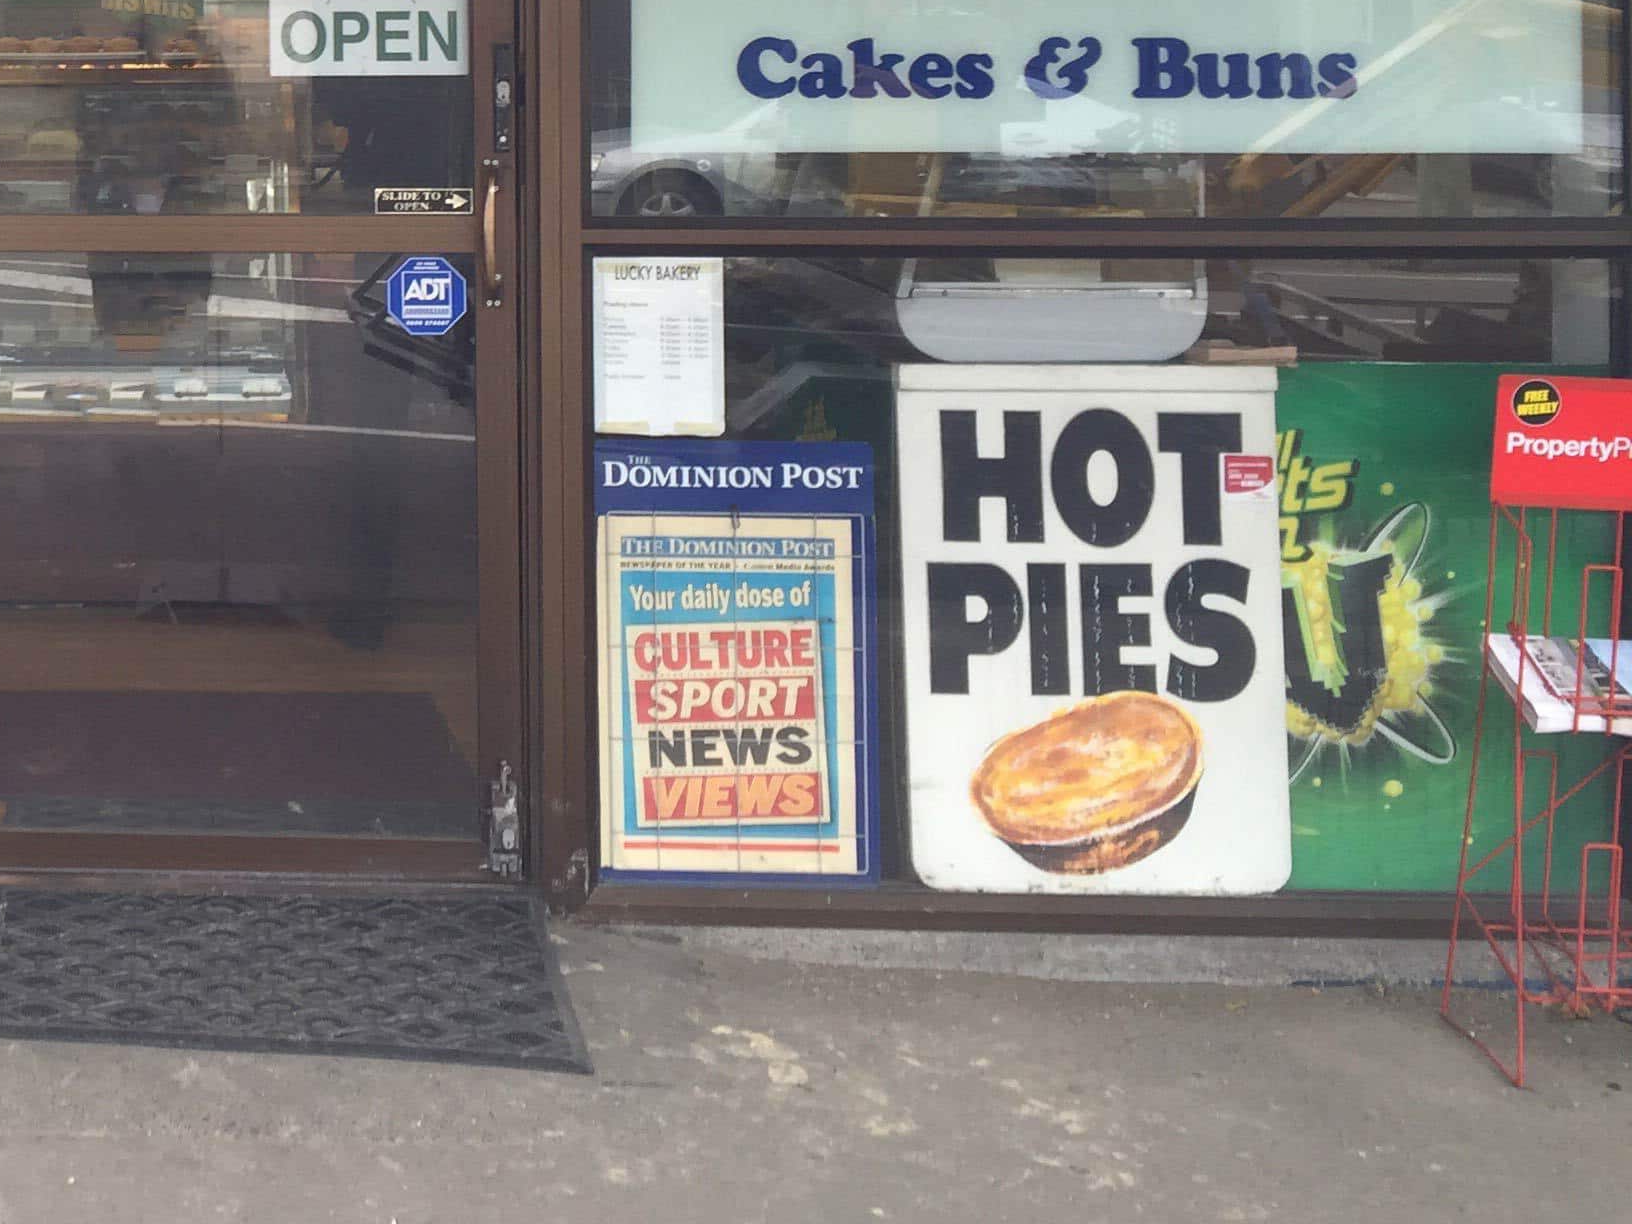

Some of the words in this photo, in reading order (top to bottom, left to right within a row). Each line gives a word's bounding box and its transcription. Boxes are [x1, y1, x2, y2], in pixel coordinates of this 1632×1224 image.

[280, 11, 458, 63] OPEN
[737, 36, 995, 100] Cakes
[1027, 36, 1101, 99] &
[1133, 37, 1358, 100] Buns
[382, 191, 420, 201] SLIDE
[423, 191, 442, 201] TO
[394, 202, 430, 211] OPEN
[615, 265, 653, 280] LUCKY
[656, 264, 702, 280] BAKERY
[404, 277, 450, 301] ADT
[1517, 402, 1560, 416] WEEKLY
[1524, 389, 1549, 403] FREE
[628, 455, 652, 465] THE
[1505, 431, 1632, 463] PropertyP
[602, 460, 773, 488] DOMINION
[781, 462, 864, 489] POST
[939, 408, 1243, 548] HOT
[622, 538, 664, 556] THE
[669, 538, 776, 557] DOMINION
[781, 540, 834, 558] POST
[620, 562, 673, 570] NEWSPAPER
[675, 562, 687, 570] OF
[689, 562, 705, 570] THE
[707, 562, 732, 570] YEAR
[629, 584, 676, 612] Your
[681, 583, 732, 615] daily
[735, 582, 785, 608] dose
[789, 580, 812, 606] of
[925, 558, 1257, 703] PIES
[634, 629, 815, 672] CULTURE
[647, 678, 812, 721] SPORT
[648, 726, 813, 770] NEWS
[649, 774, 817, 819] VIEWS
